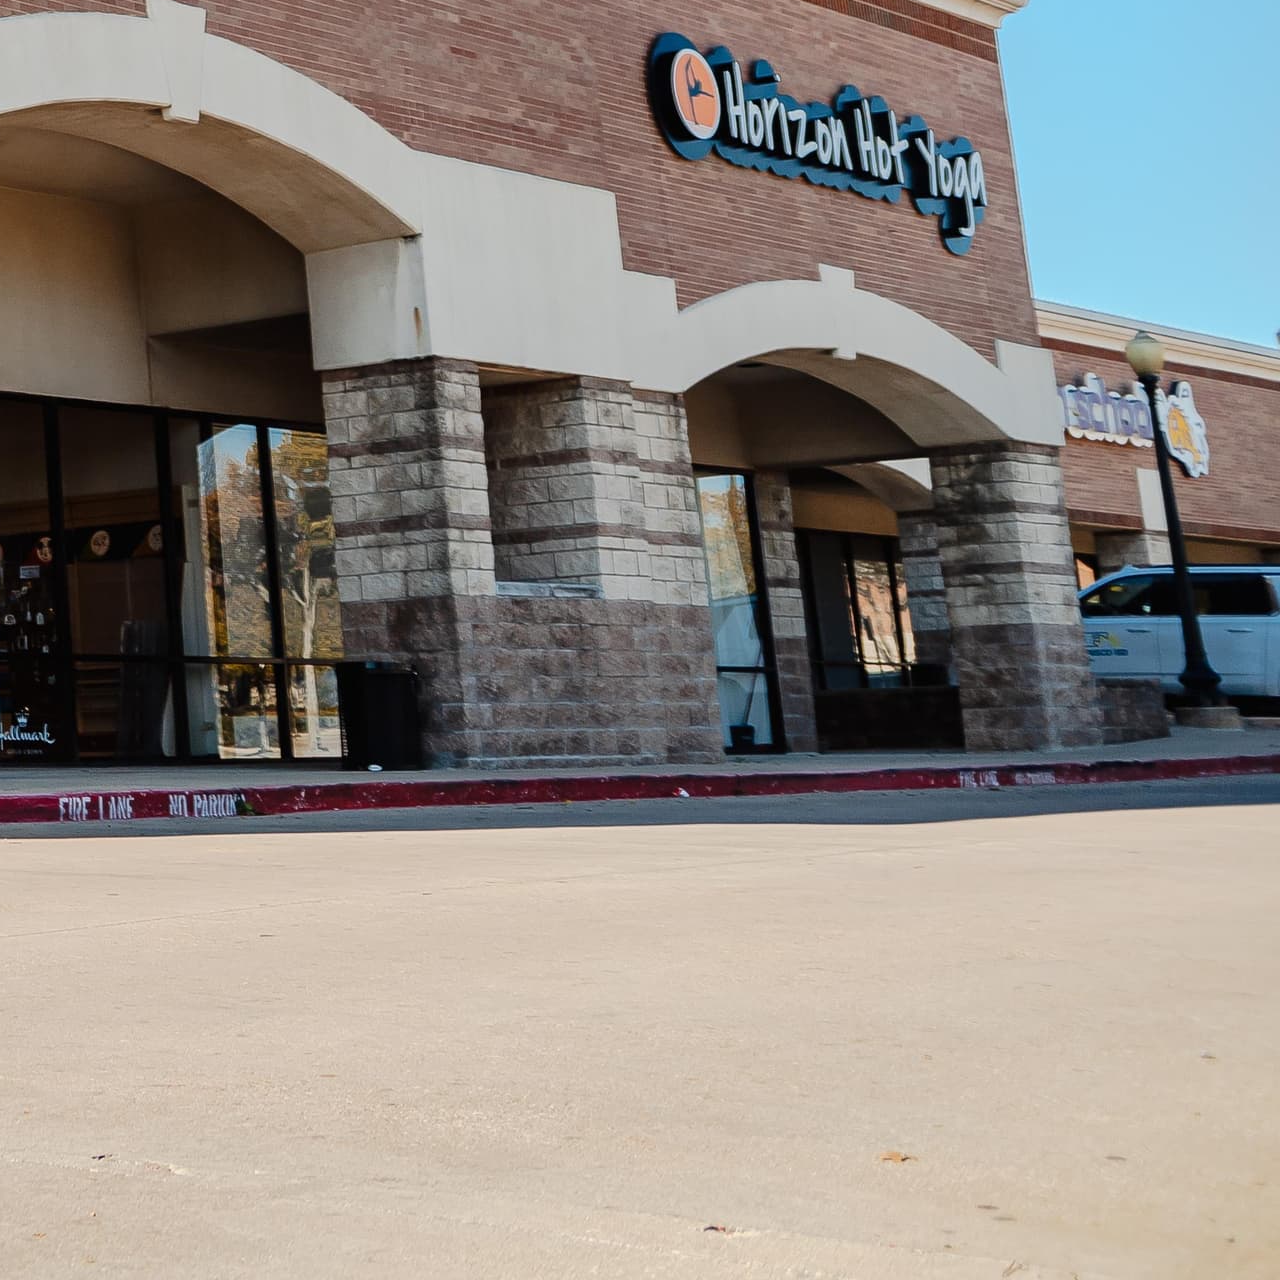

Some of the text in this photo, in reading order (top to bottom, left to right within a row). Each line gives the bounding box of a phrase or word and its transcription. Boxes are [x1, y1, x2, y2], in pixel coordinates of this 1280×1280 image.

[722, 60, 988, 237] Horizon Hot Yoga
[58, 796, 92, 821] FIRE
[98, 795, 135, 821] LANE
[168, 793, 189, 818] NO
